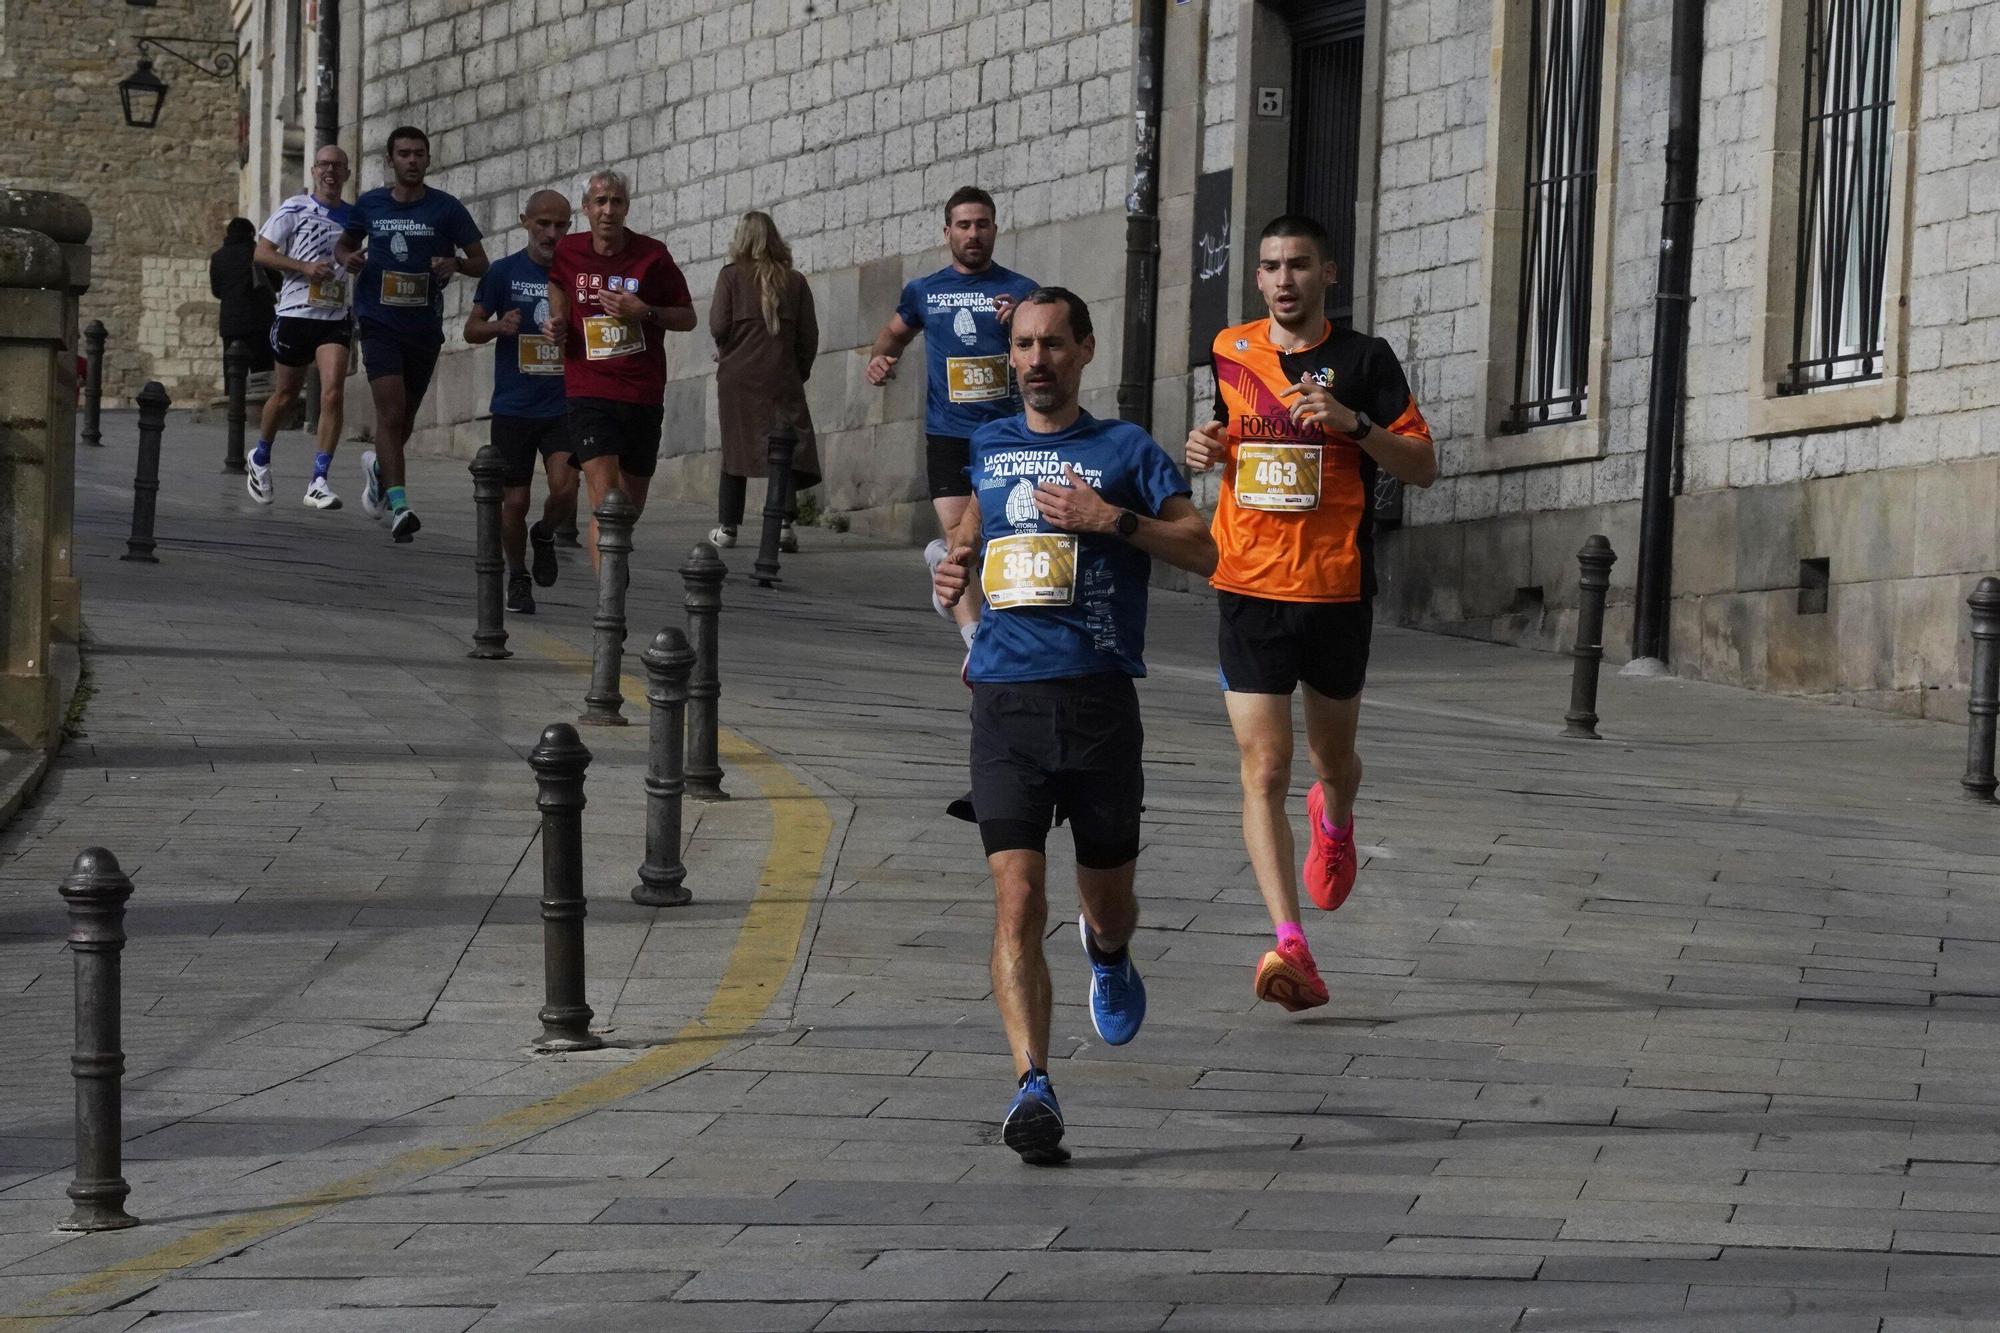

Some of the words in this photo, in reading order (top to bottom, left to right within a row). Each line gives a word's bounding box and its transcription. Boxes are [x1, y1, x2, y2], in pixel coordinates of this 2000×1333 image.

[396, 282, 416, 294] 119
[521, 282, 549, 290] CONQU
[523, 289, 549, 297] ALME
[937, 292, 985, 300] CONQUISTA
[939, 297, 995, 307] ALMENDR
[601, 326, 628, 343] 307
[535, 345, 560, 360] 193
[963, 367, 994, 385] 353
[984, 455, 993, 466] LA
[994, 451, 1059, 464] CONQUISTA
[993, 461, 1085, 478] ALMENDRA
[1085, 469, 1103, 477] REN
[1255, 461, 1297, 486] 463
[1037, 475, 1103, 489] KONTA
[1057, 540, 1071, 548] 10K
[1003, 551, 1050, 580] 356
